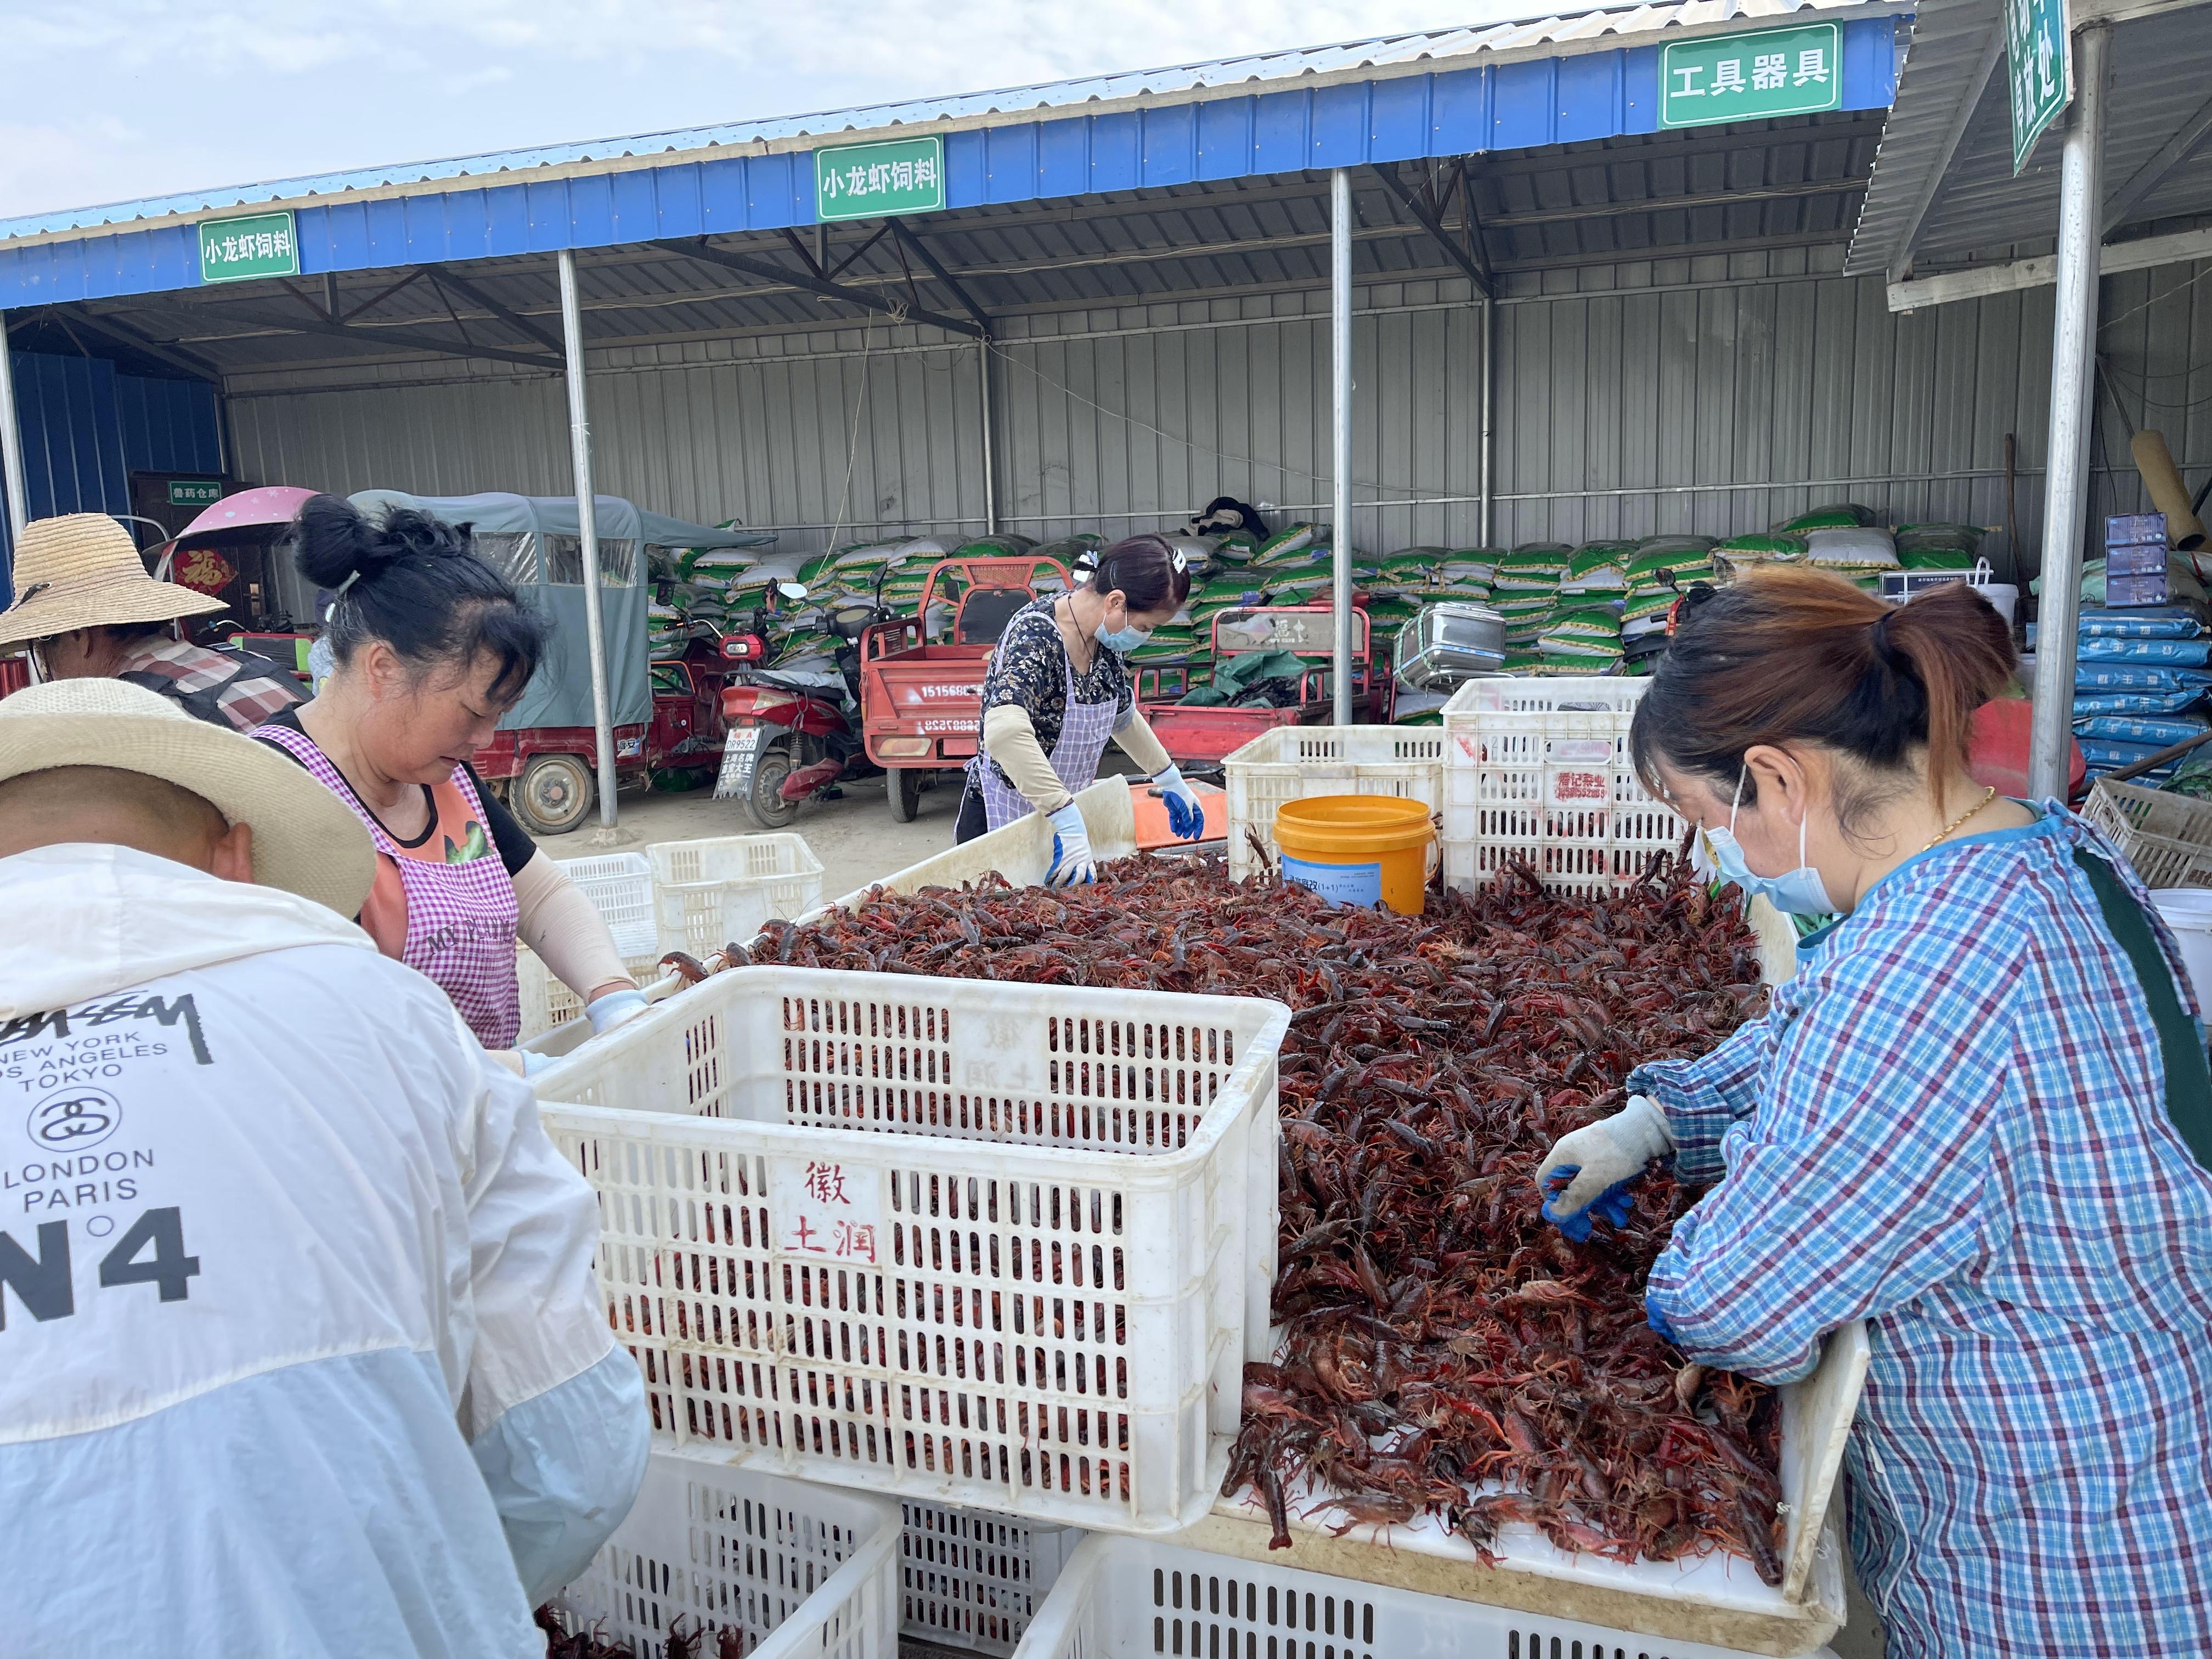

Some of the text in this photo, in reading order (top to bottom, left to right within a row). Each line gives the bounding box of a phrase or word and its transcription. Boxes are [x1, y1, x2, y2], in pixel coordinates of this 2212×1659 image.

[1670, 48, 1830, 98] 工具器具
[823, 157, 936, 198] 小龙虾饲料
[205, 229, 291, 264] 小龙虾饲料
[182, 549, 223, 586] 福
[726, 739, 756, 750] DR9522
[427, 923, 458, 957] MY
[39, 1043, 167, 1071] ANGELES
[65, 1031, 141, 1051] YORK
[18, 1064, 122, 1092] TOKYO
[4, 1149, 154, 1189] LONDON
[24, 1178, 138, 1213] PARIS
